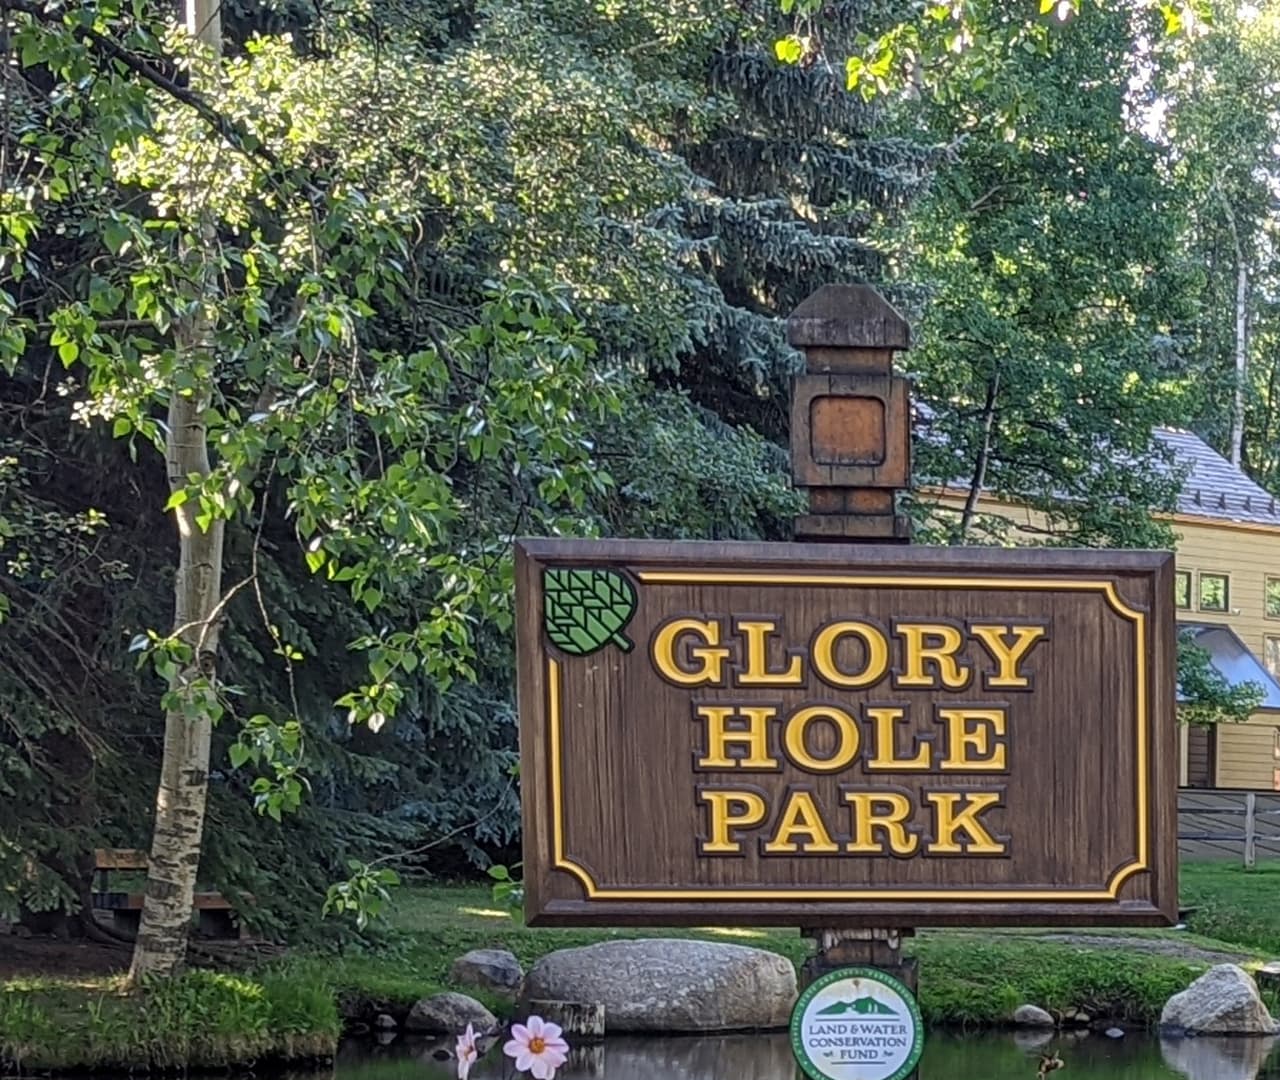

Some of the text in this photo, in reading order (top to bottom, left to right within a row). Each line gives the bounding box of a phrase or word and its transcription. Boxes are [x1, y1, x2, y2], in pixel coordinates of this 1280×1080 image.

[652, 618, 1045, 687] GLORY
[697, 705, 1006, 771] HOLE
[701, 791, 1005, 854] PARK
[808, 1024, 908, 1035] LAND & WATER
[808, 1037, 907, 1048] CONSERVATION
[840, 1049, 879, 1060] FUND
